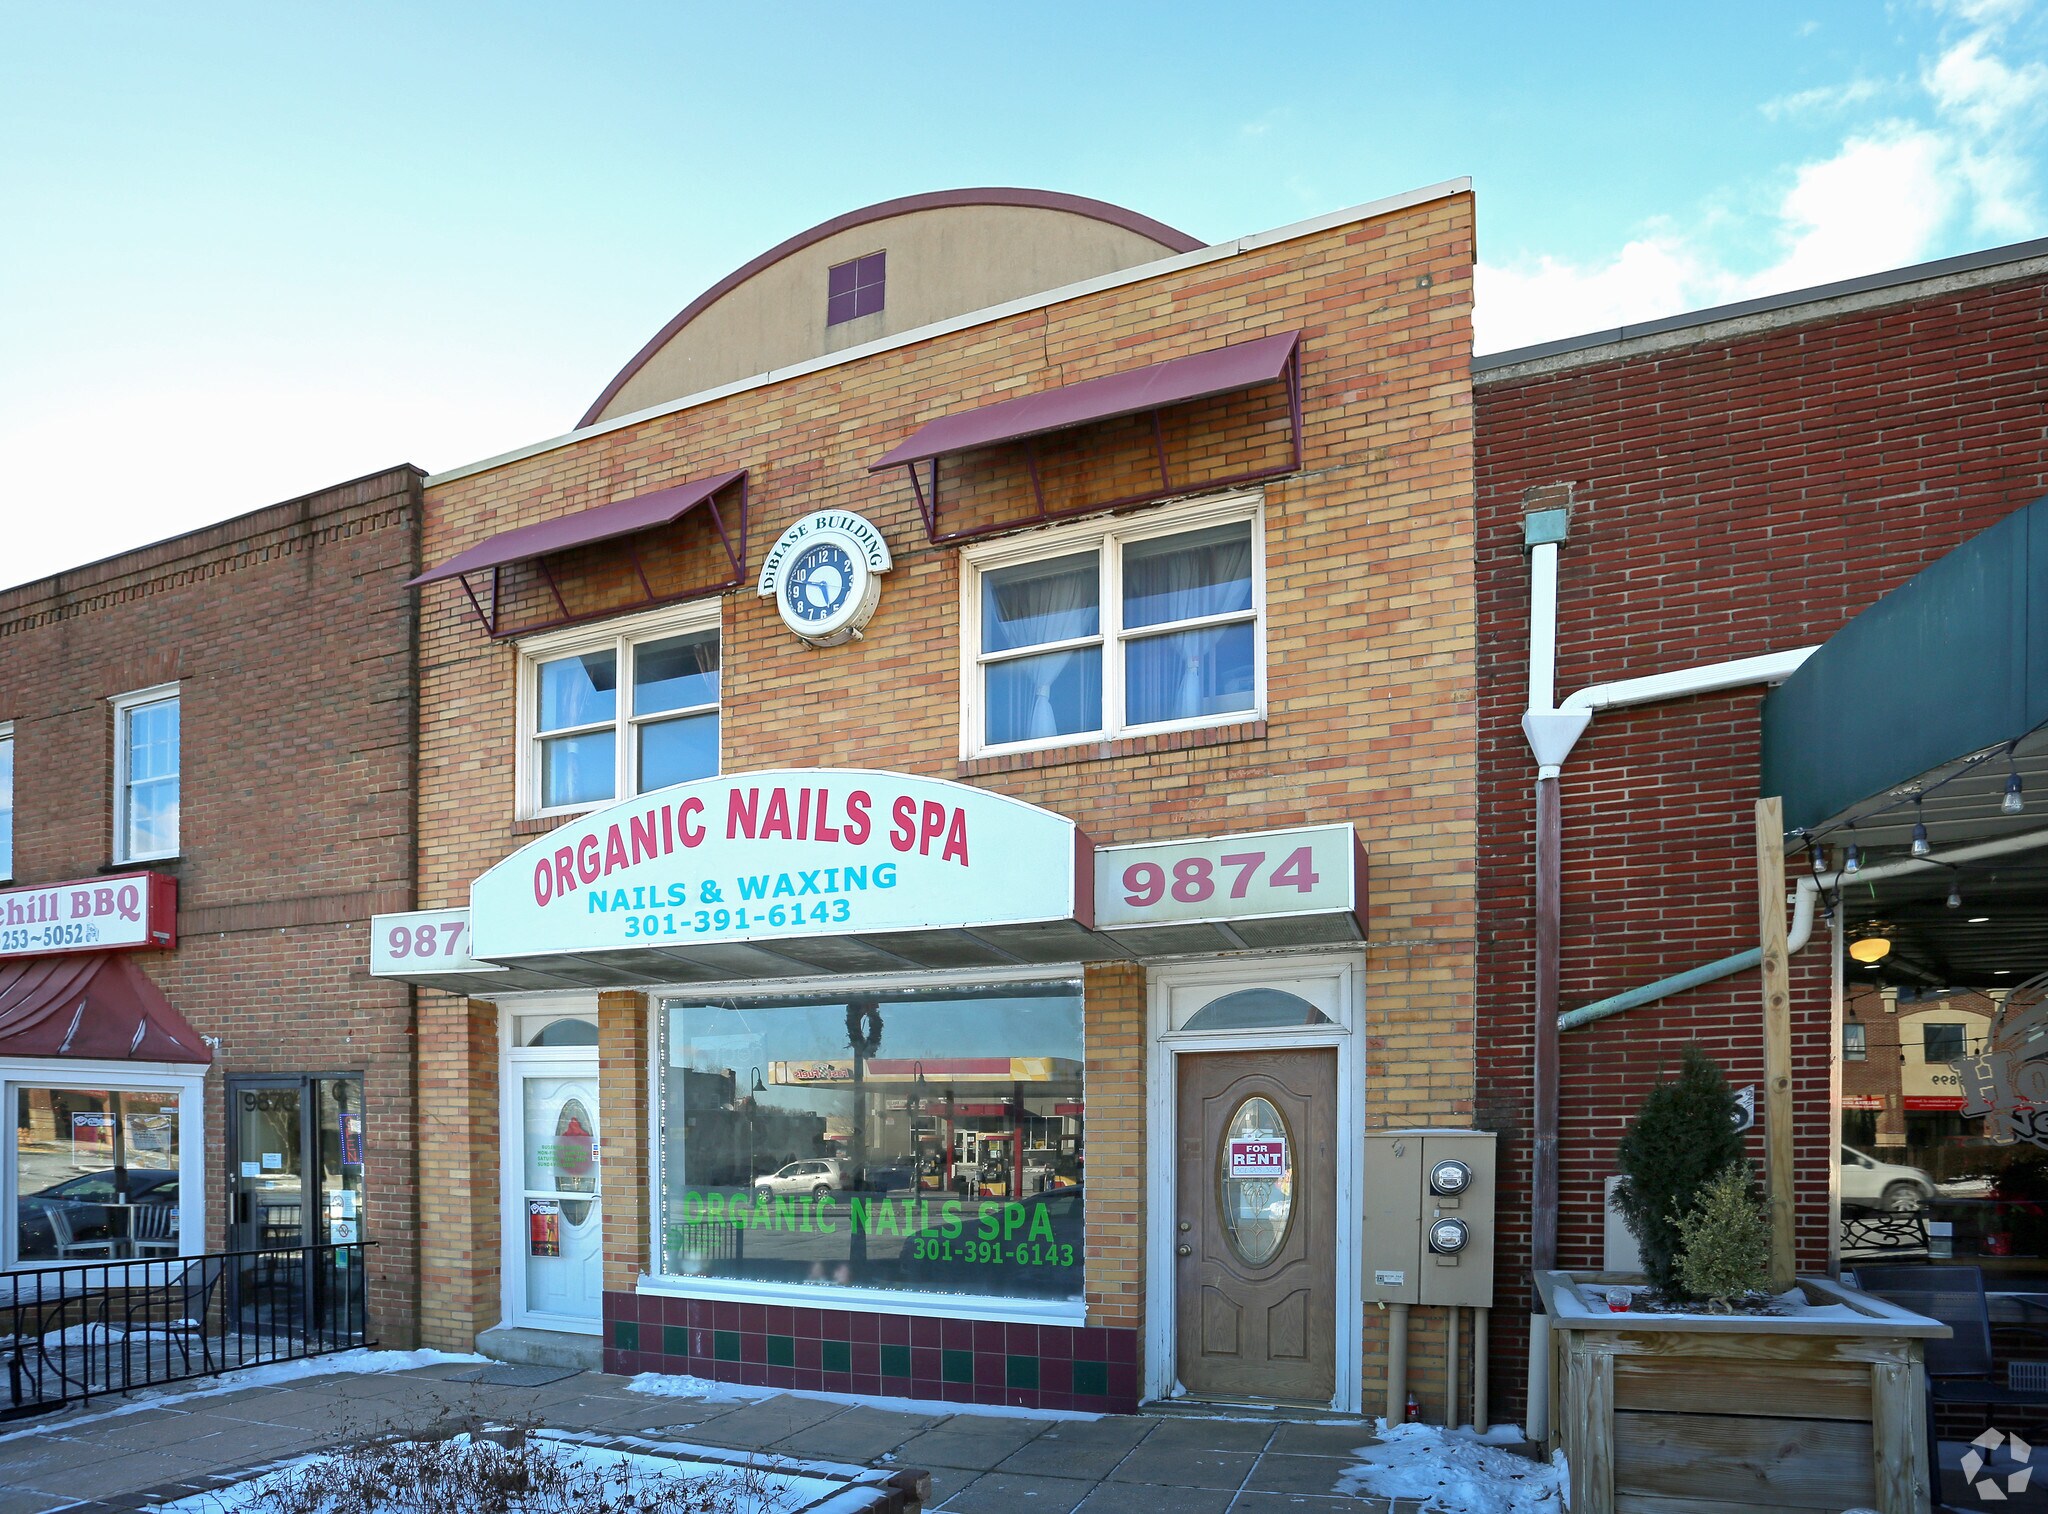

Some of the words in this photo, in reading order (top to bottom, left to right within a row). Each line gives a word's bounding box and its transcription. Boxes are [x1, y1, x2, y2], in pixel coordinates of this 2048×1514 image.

[815, 516, 883, 566] BUILDING
[808, 556, 816, 568] 11
[819, 550, 828, 563] 12
[834, 550, 838, 562] 1
[844, 560, 851, 572] 2
[797, 569, 806, 581] 10
[793, 586, 800, 598] 9
[797, 601, 804, 612] 8
[808, 609, 814, 620] 7
[820, 610, 827, 620] 6
[533, 797, 706, 907] ORGANIC
[726, 787, 872, 846] NAILS
[890, 796, 969, 868] SPA
[1122, 846, 1319, 908] 9874
[588, 882, 686, 914] NAILS
[700, 880, 724, 903] &
[737, 863, 897, 900] WAXING
[70, 884, 141, 922] BBQ
[624, 899, 851, 938] 301-391-6143
[388, 922, 470, 959] 987
[1246, 1145, 1268, 1153] FOR
[1233, 1153, 1281, 1165] RENT
[683, 1191, 836, 1234] ORGANIC
[851, 1197, 962, 1239] NAILS
[978, 1200, 1054, 1243] SPA
[913, 1238, 1074, 1267] 301-391-6143
